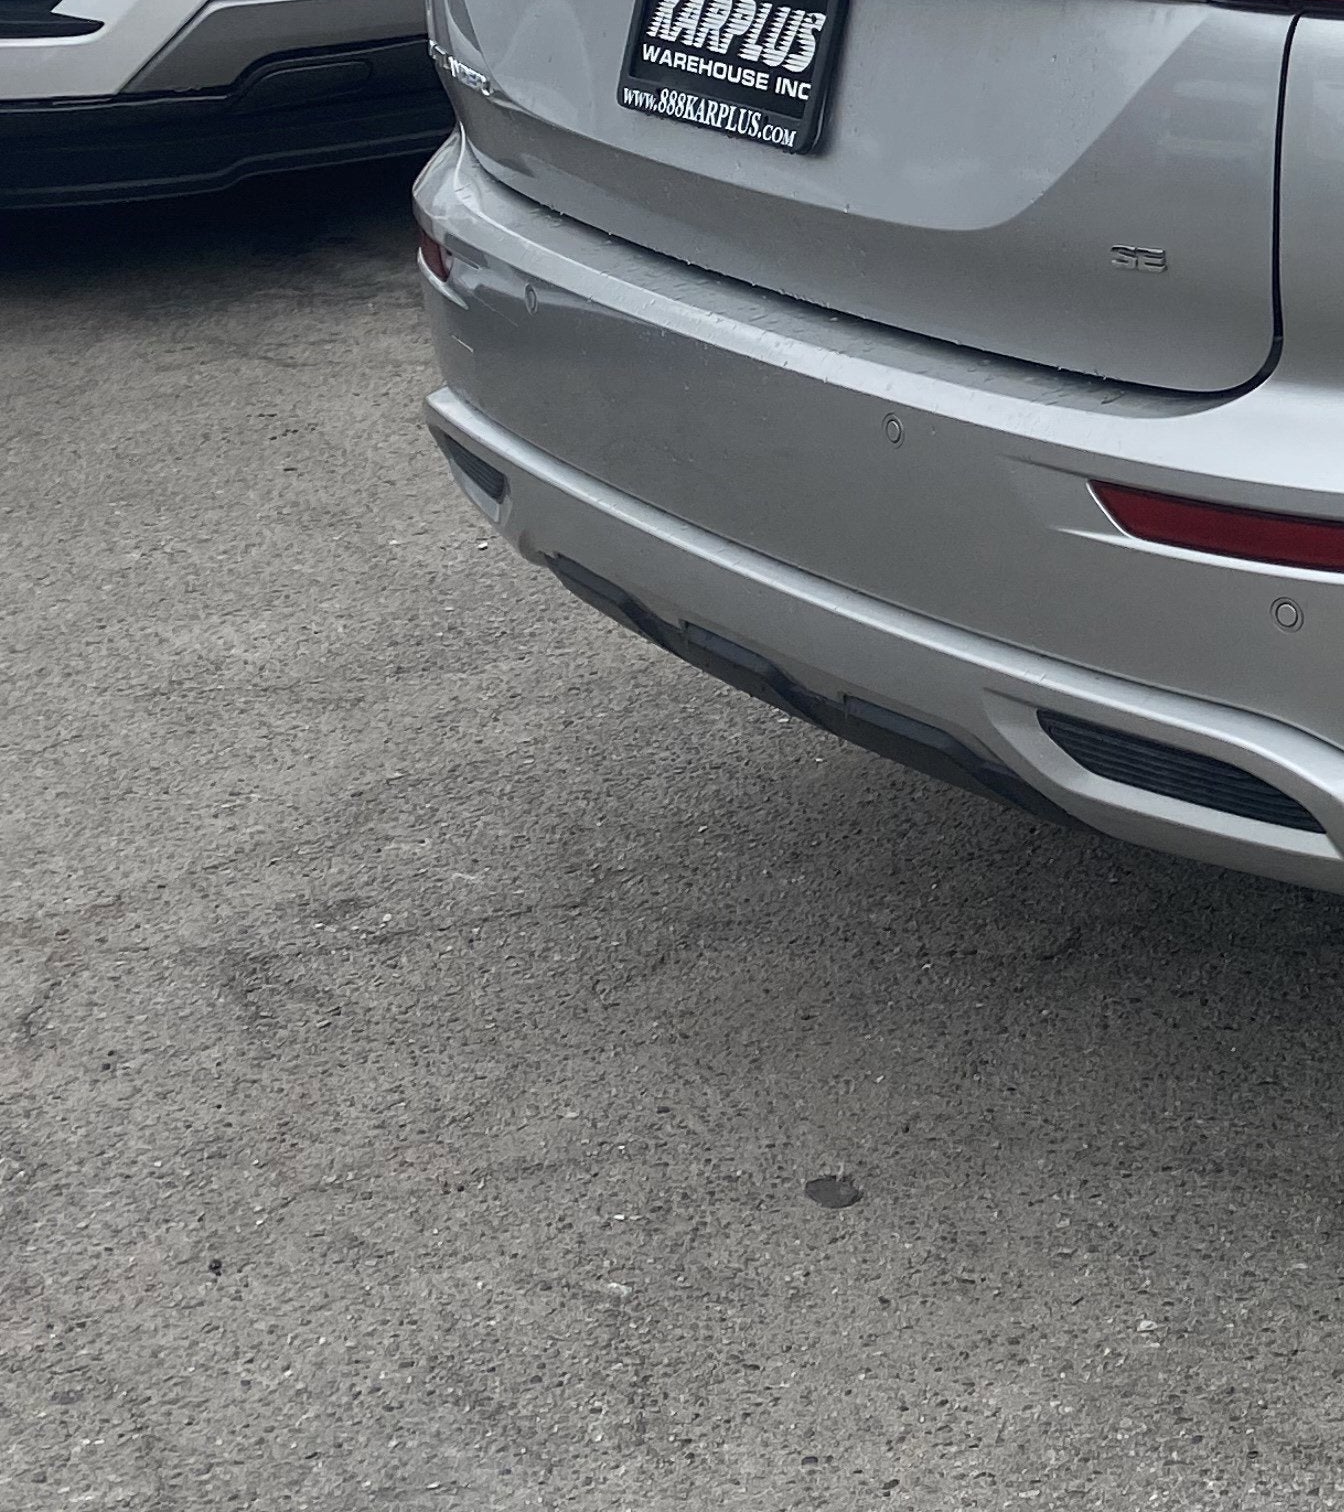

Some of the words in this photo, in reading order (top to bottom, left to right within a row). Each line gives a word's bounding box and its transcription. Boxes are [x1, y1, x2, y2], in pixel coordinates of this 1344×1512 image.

[641, 43, 770, 91] WAREHOUSE
[775, 76, 812, 101] INC
[1110, 244, 1167, 273] SE
